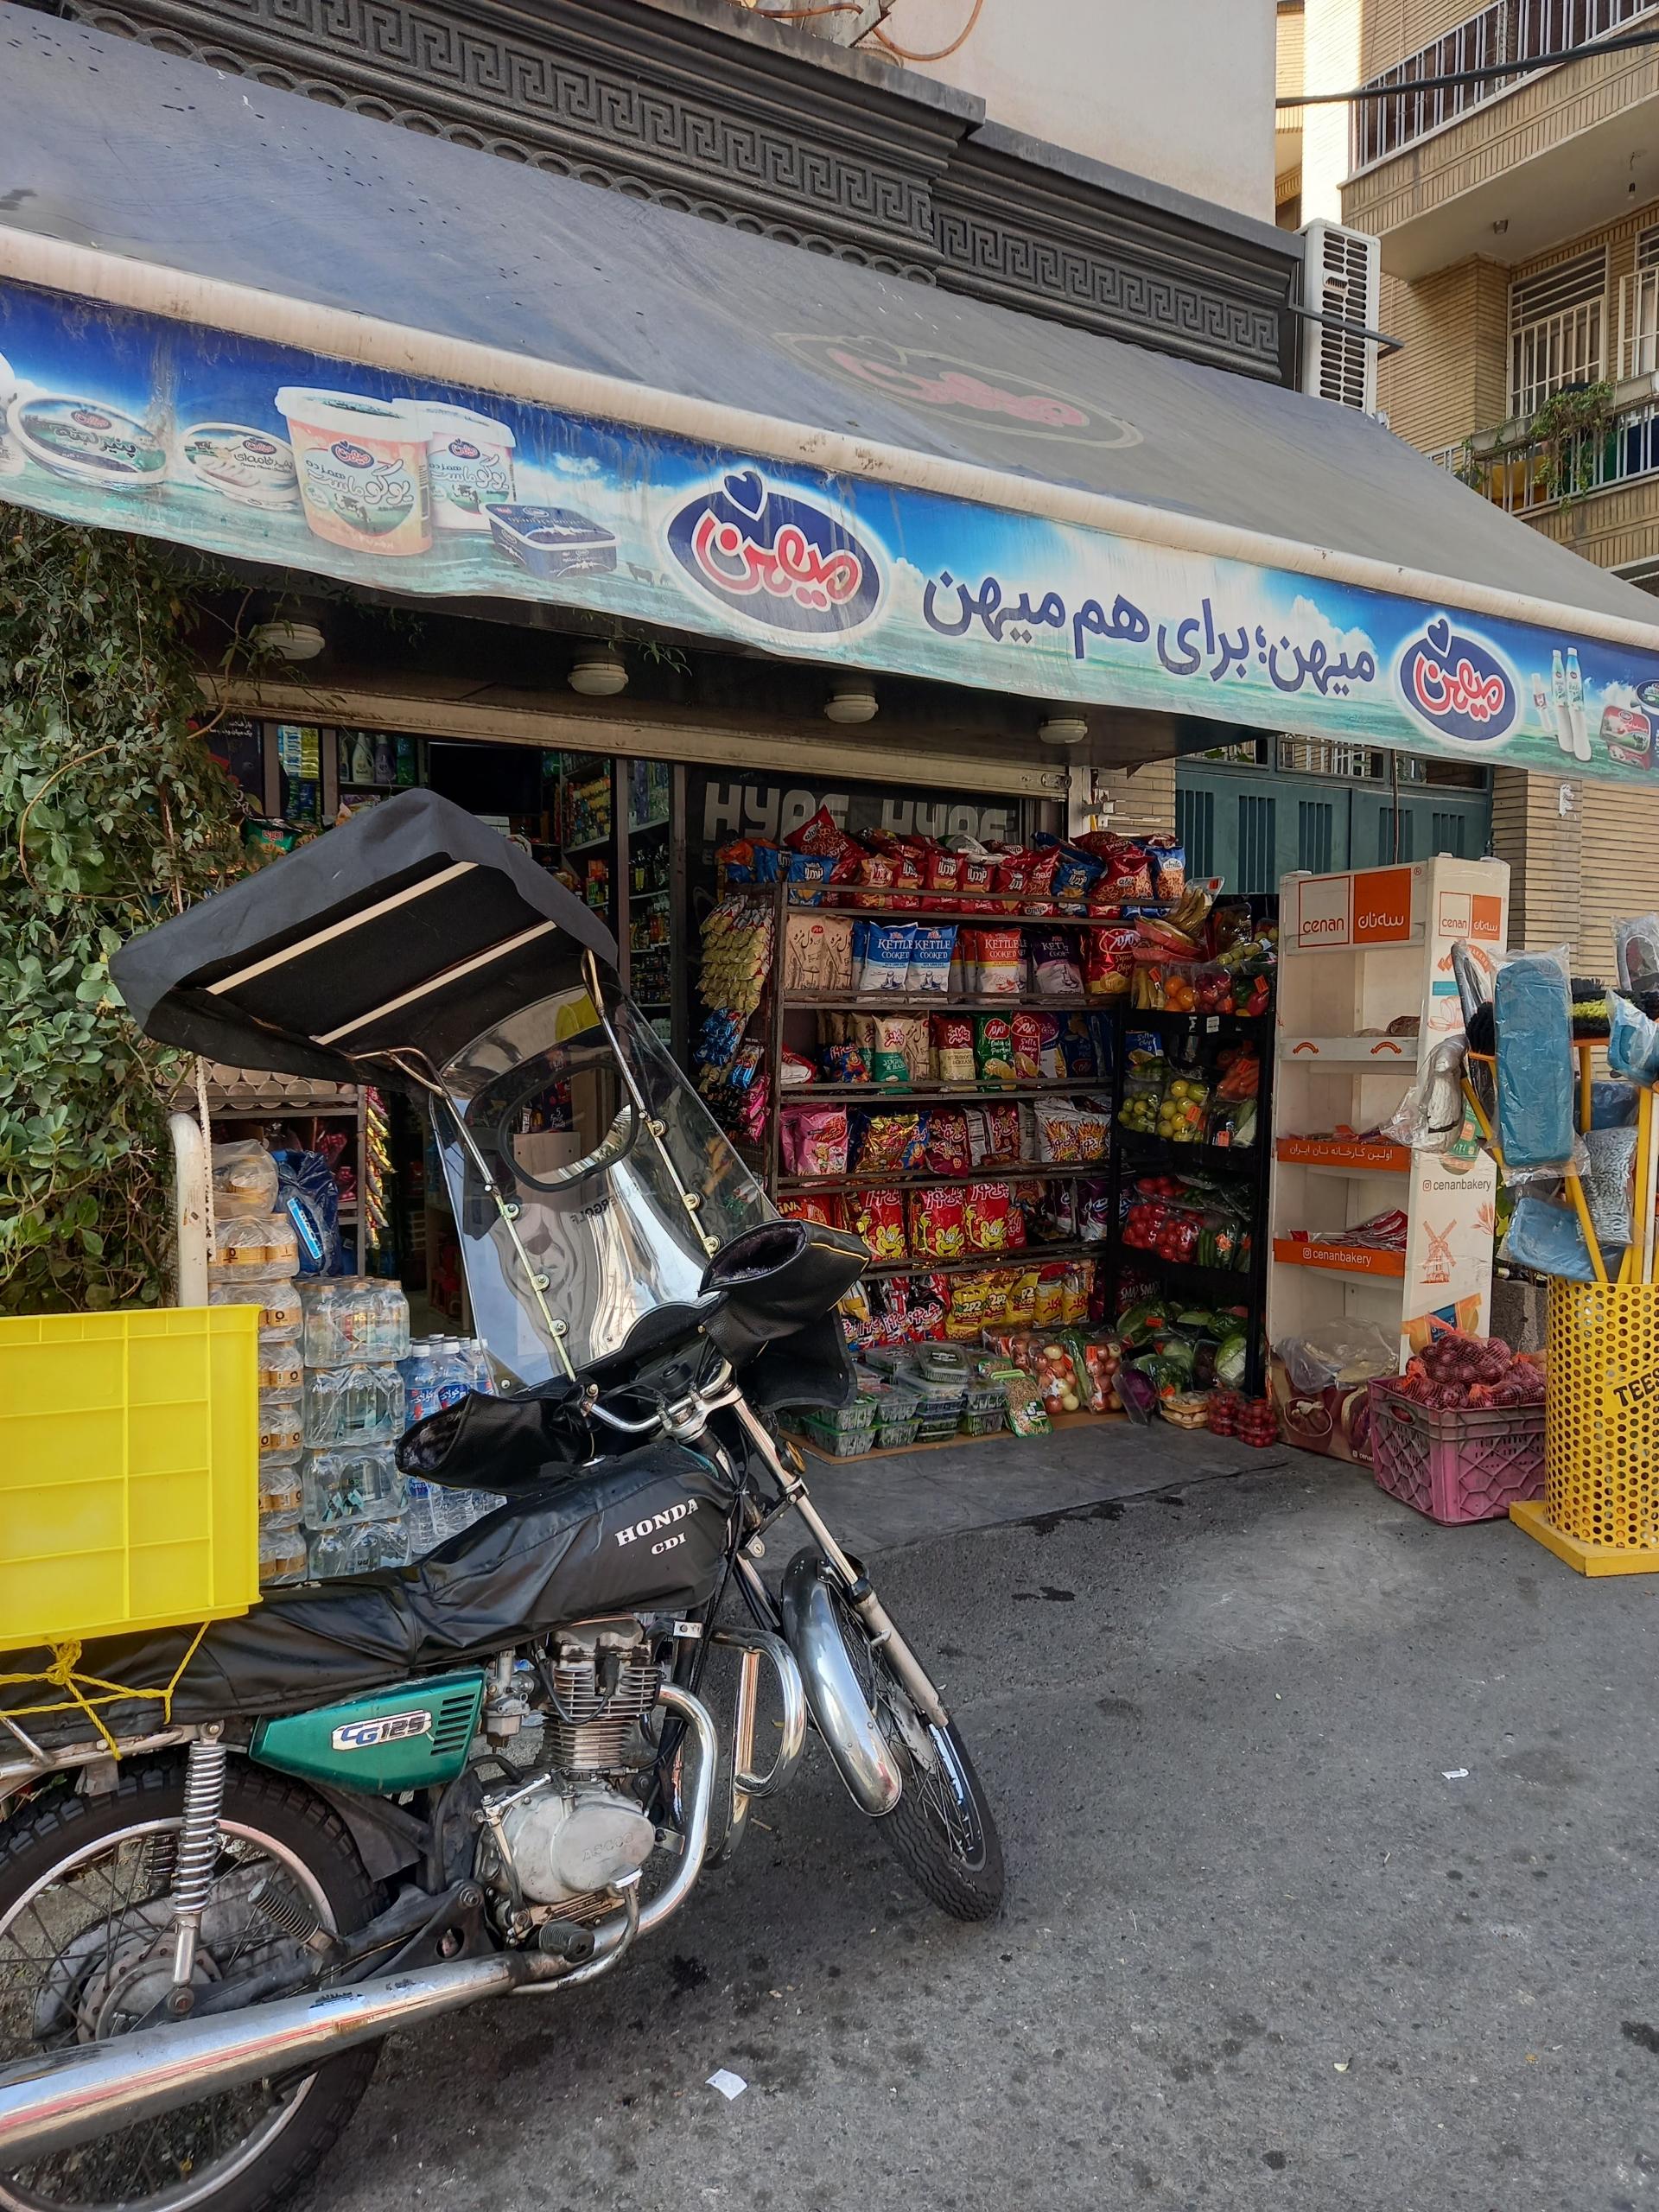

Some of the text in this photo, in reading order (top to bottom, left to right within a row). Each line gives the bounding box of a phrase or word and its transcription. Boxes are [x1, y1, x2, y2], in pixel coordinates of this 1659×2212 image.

[335, 446, 371, 466] میهن
[694, 513, 861, 609] میهن
[1156, 598, 1249, 683] برای
[1411, 654, 1507, 724] میهن
[1302, 918, 1344, 934] cenan
[1441, 918, 1467, 930] cenan
[878, 939, 913, 950] KETTLE
[914, 939, 952, 950] KETTLE
[985, 939, 1019, 950] KETTLE
[919, 951, 948, 960] COOKED
[1289, 1143, 1393, 1161] اولین کارخانه نان ایران
[1433, 1179, 1491, 1192] cenanbakery
[1313, 1249, 1373, 1268] cenanbakery
[614, 1498, 699, 1547] HONDA
[651, 1532, 687, 1555] CDI
